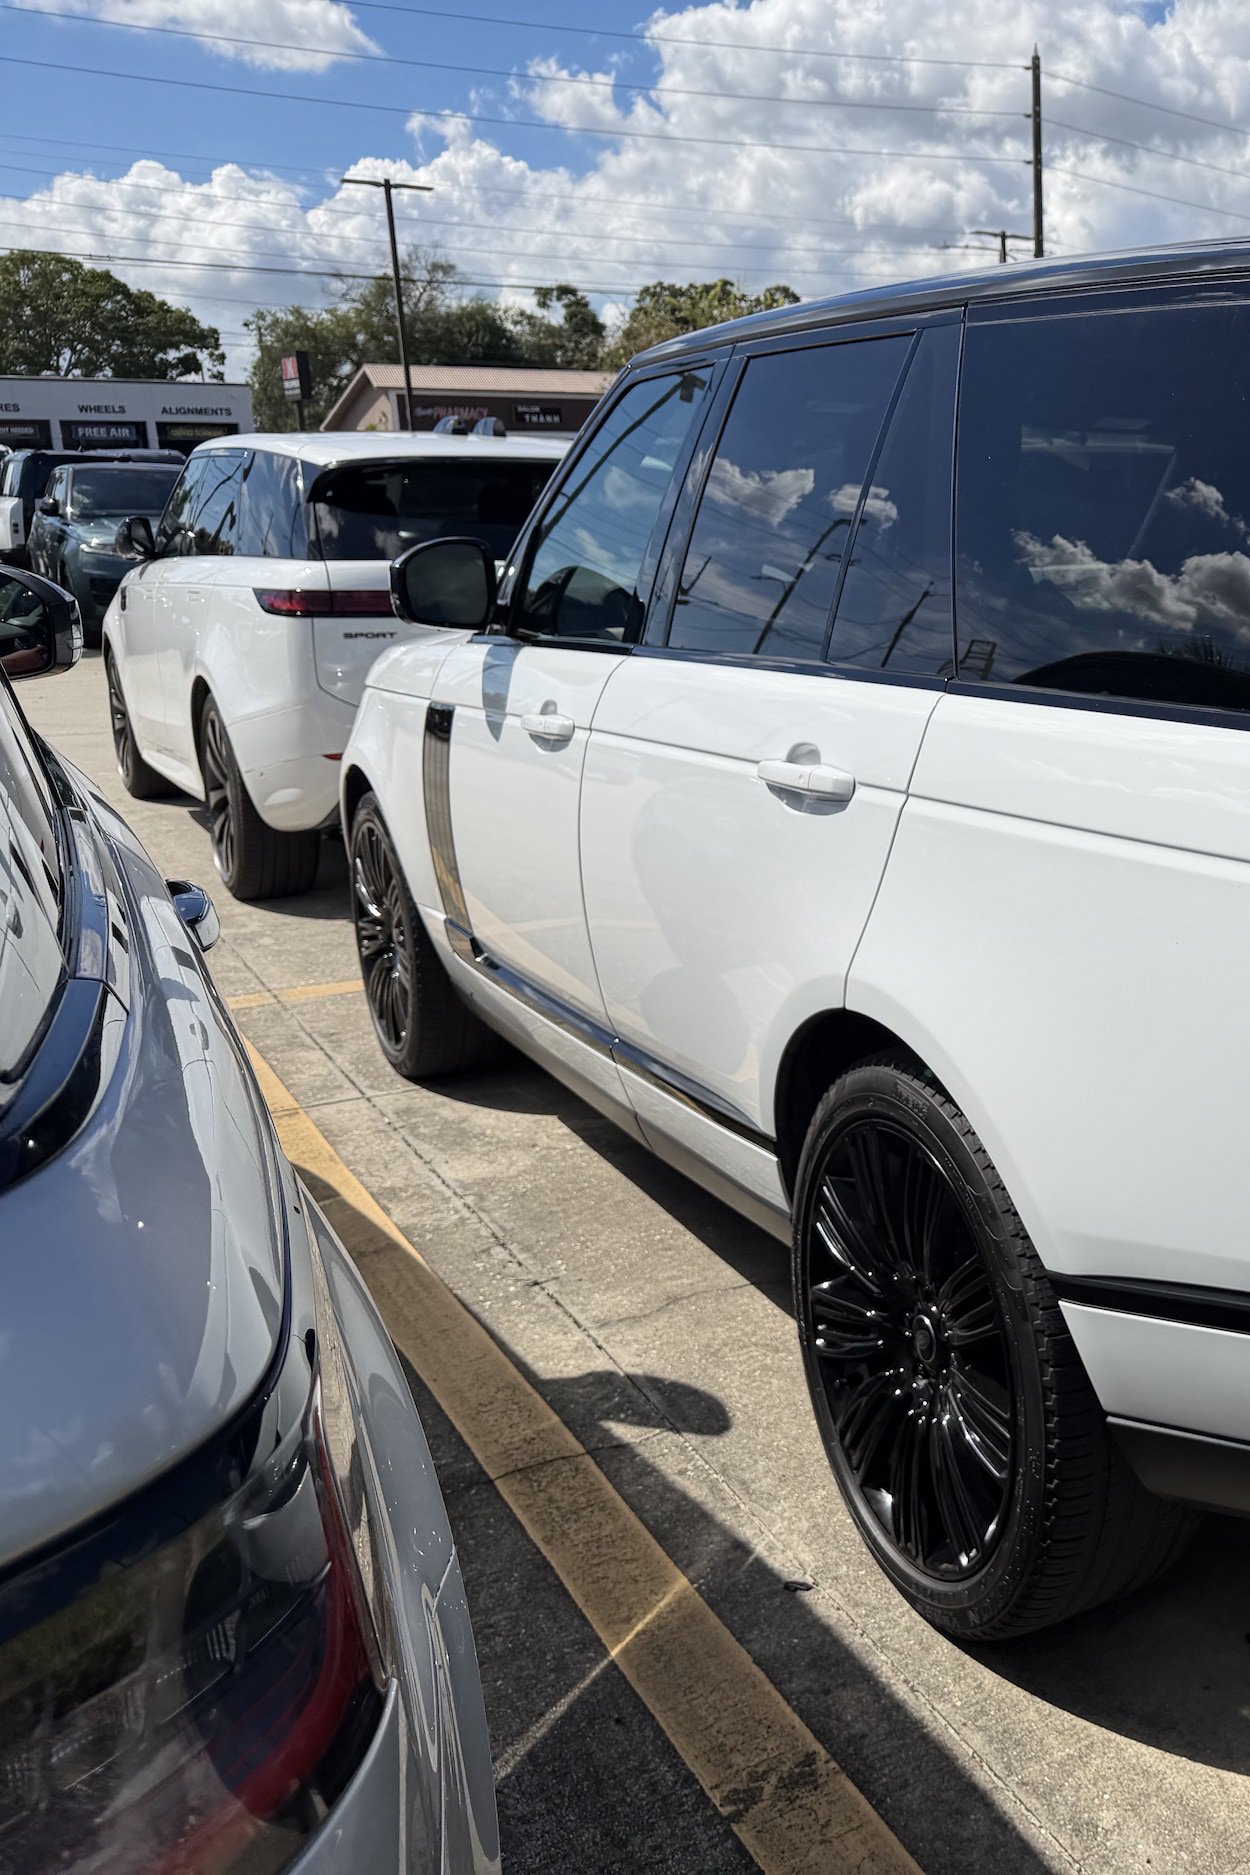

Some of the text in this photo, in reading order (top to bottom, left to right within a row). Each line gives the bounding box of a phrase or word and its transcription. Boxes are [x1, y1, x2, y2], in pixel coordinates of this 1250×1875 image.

[77, 404, 126, 414] WHEELS
[161, 406, 232, 417] ALIGNMENTS
[77, 427, 130, 438] FREE AIR
[343, 631, 398, 640] SPORT
